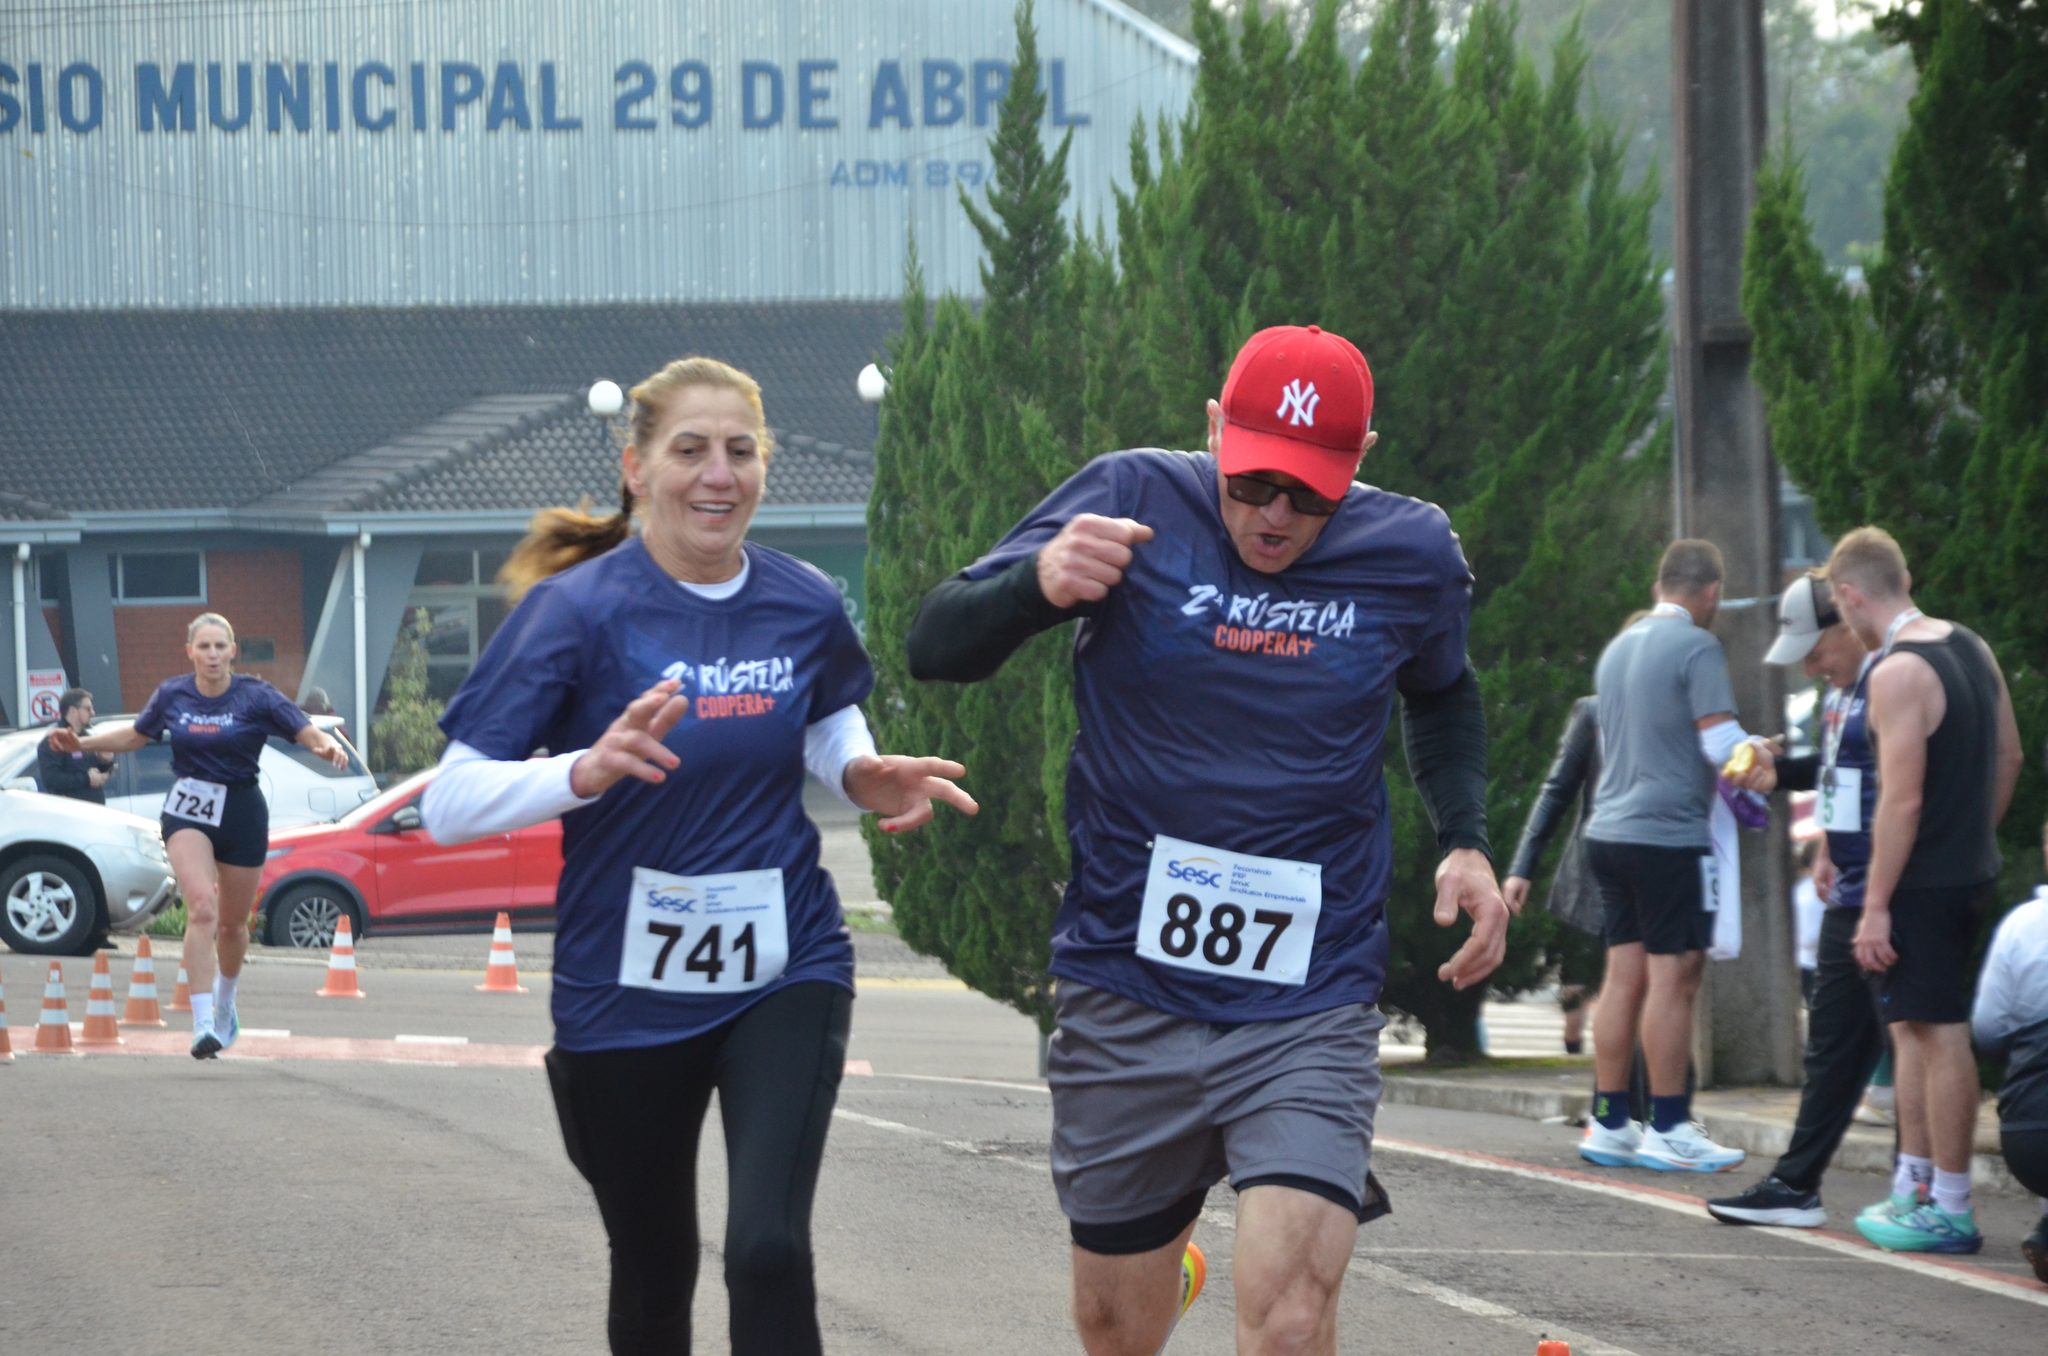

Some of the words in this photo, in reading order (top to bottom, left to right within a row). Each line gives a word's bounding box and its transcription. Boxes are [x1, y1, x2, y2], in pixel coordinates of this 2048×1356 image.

[135, 61, 582, 133] MUNICIPAL
[613, 60, 713, 130] 29
[741, 60, 839, 130] DE
[868, 57, 1092, 128] ABRL
[829, 159, 909, 187] ADM
[1276, 378, 1320, 427] NY
[1227, 592, 1357, 637] RÚSTICA
[1214, 623, 1317, 657] COOPERA+
[699, 656, 793, 693] RÚSTICA
[696, 693, 776, 719] COOPERA+
[175, 790, 215, 820] 724
[647, 919, 758, 983] 741
[1159, 892, 1294, 972] 887
